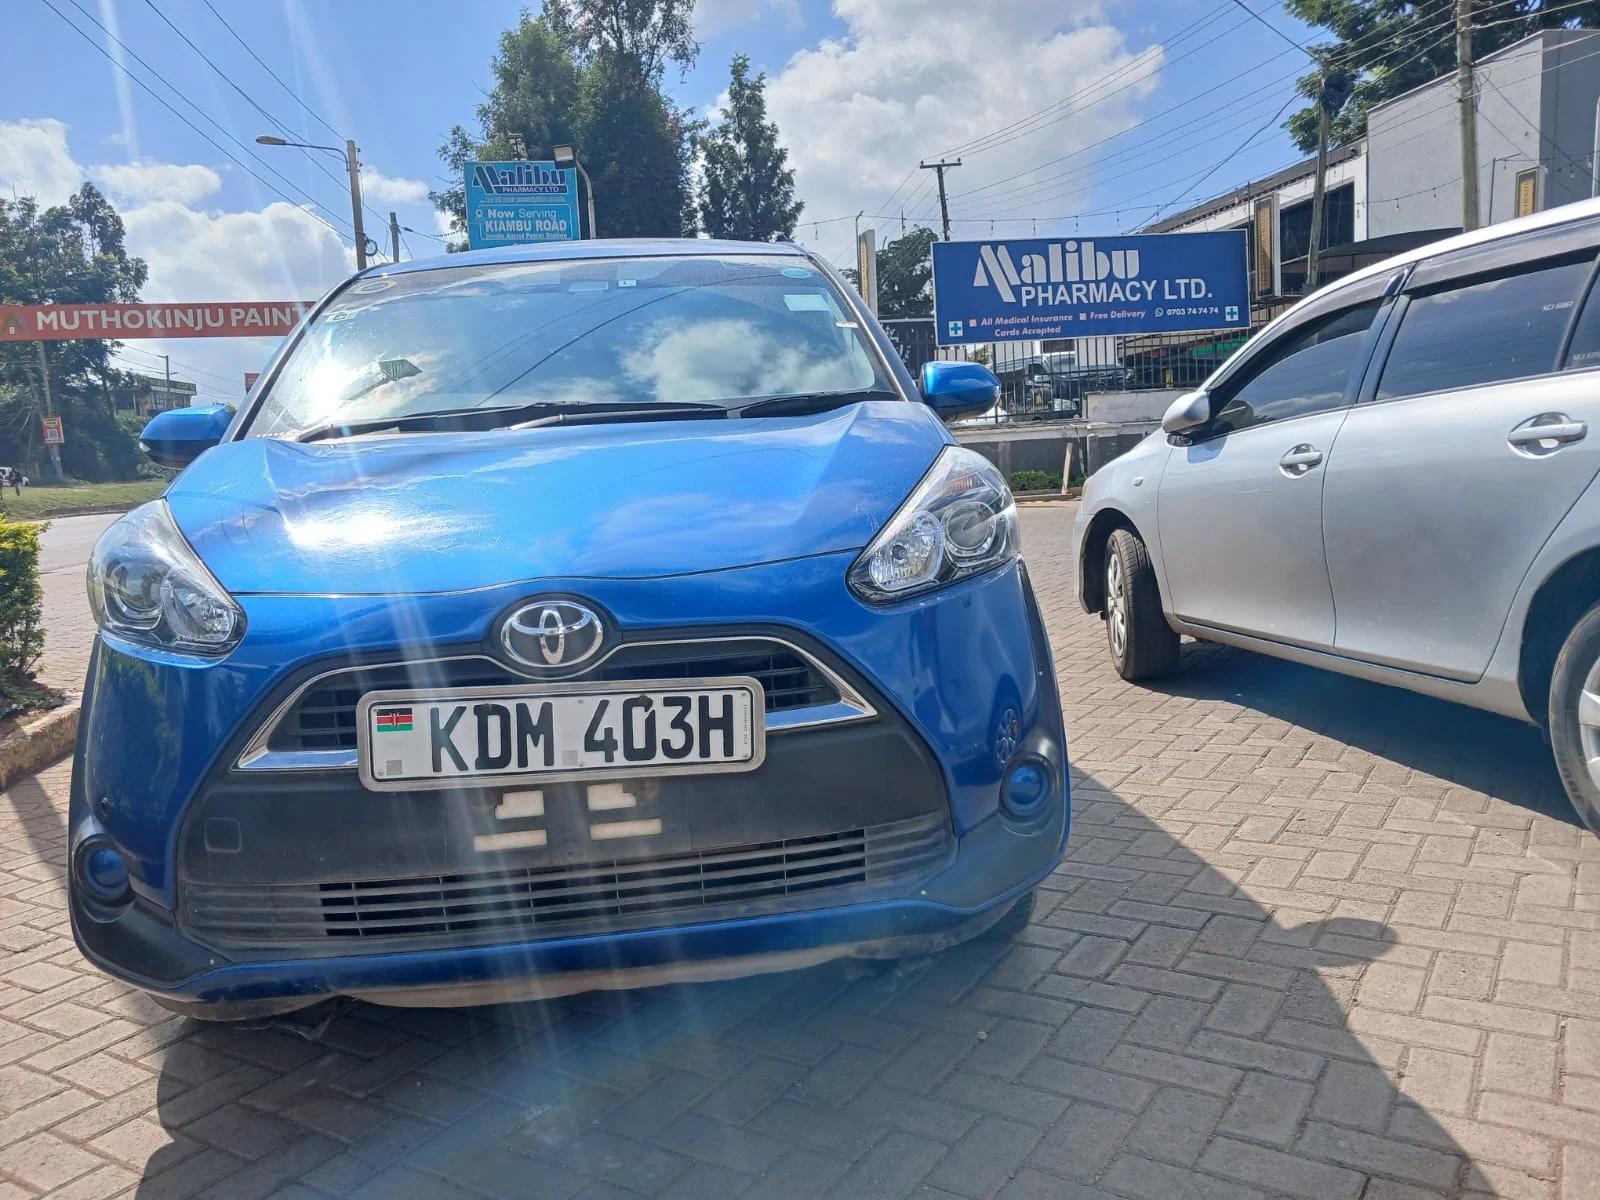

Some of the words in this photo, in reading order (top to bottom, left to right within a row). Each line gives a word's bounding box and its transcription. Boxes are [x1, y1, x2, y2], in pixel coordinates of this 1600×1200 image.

[472, 164, 566, 194] Malibu
[488, 209, 515, 218] Now
[518, 208, 557, 222] Serving
[485, 220, 532, 233] KIAMBU
[536, 220, 567, 232] ROAD
[973, 240, 1140, 303] Malibu
[1021, 279, 1158, 307] PHARMACY
[1164, 278, 1213, 300] LTD.
[1090, 311, 1109, 319] Free
[1110, 310, 1146, 319] Delivery
[1167, 308, 1186, 316] 0703
[1187, 307, 1197, 315] 74
[1198, 307, 1208, 315] 74
[1209, 306, 1219, 314] 74
[37, 307, 225, 331] MUTHOKINJU
[230, 306, 309, 327] PAINT
[981, 318, 993, 326] All
[995, 316, 1029, 325] Medical
[1031, 314, 1073, 323] Insurance
[994, 328, 1020, 337] Cards
[1022, 326, 1061, 336] Accepted
[429, 701, 555, 773] KDM
[583, 694, 735, 763] 403H
